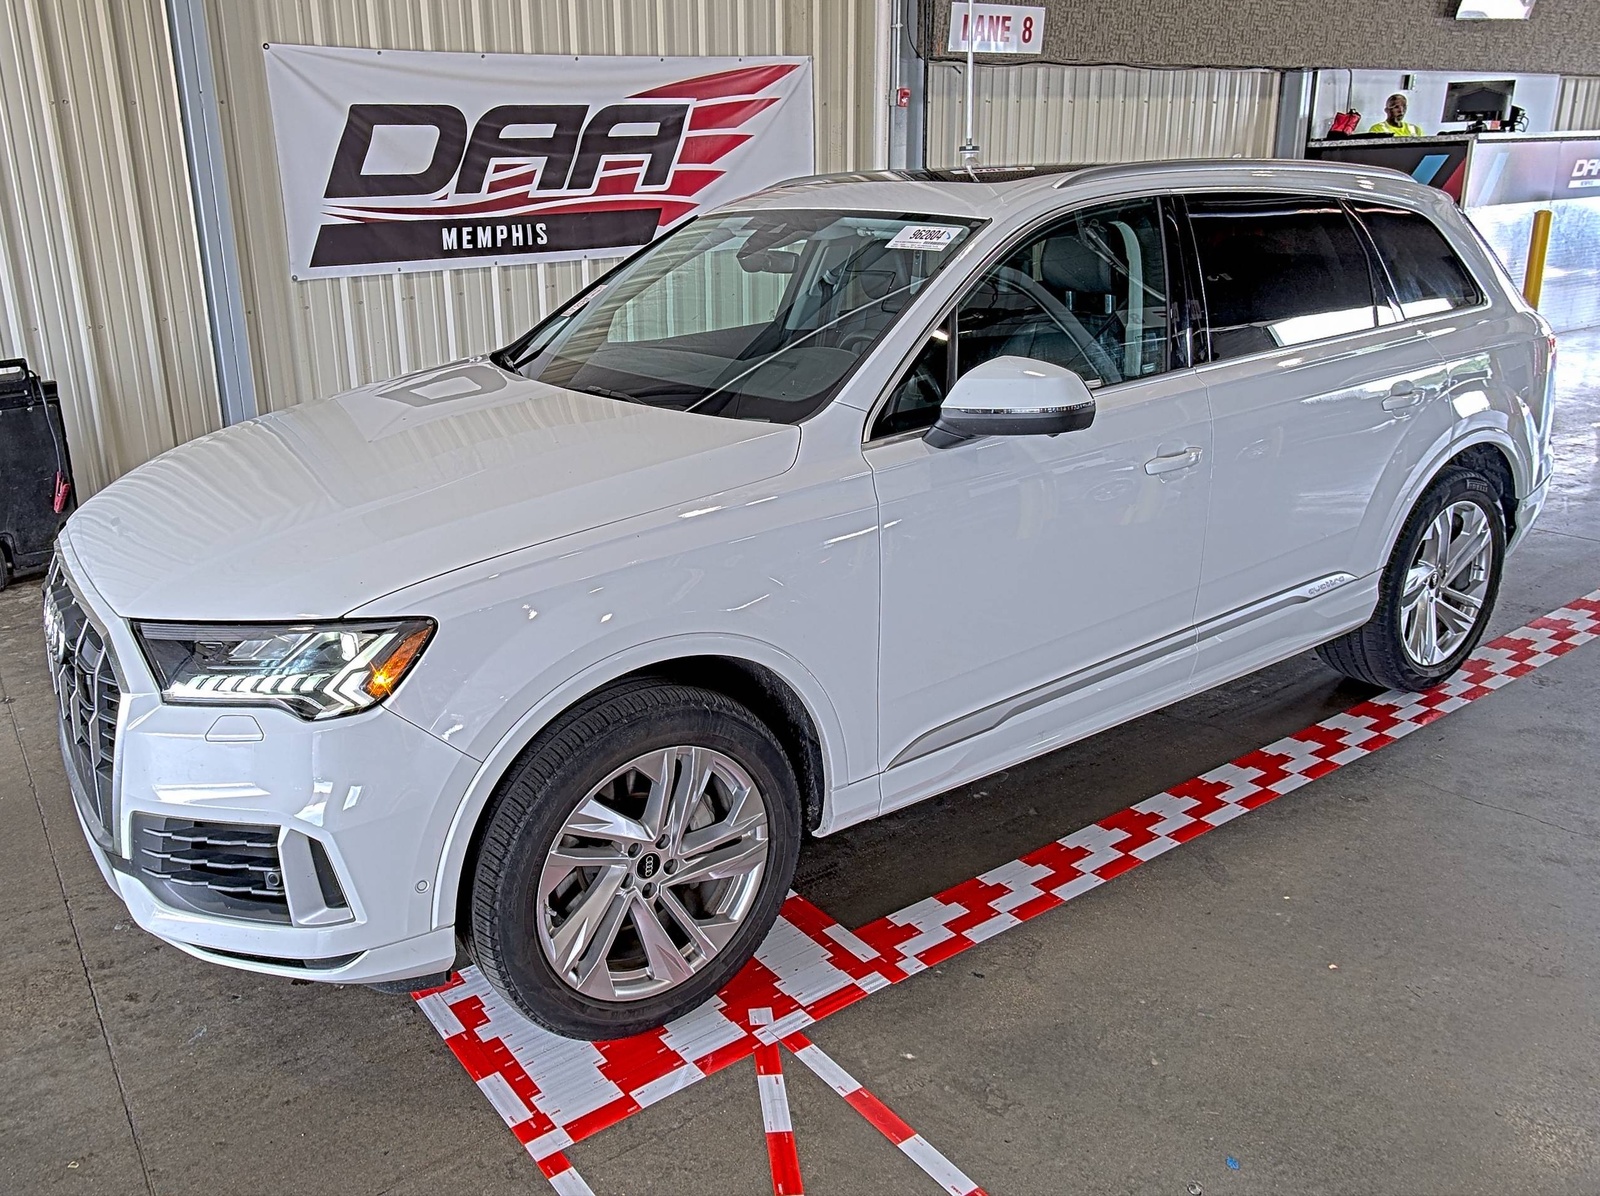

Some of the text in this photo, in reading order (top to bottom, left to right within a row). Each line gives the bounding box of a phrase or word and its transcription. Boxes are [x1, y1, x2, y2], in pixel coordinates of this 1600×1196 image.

[961, 14, 1033, 44] LANE 8
[323, 103, 691, 198] DAA
[1571, 158, 1600, 177] DA
[441, 222, 548, 250] MEMPHIS
[909, 229, 946, 240] 962804
